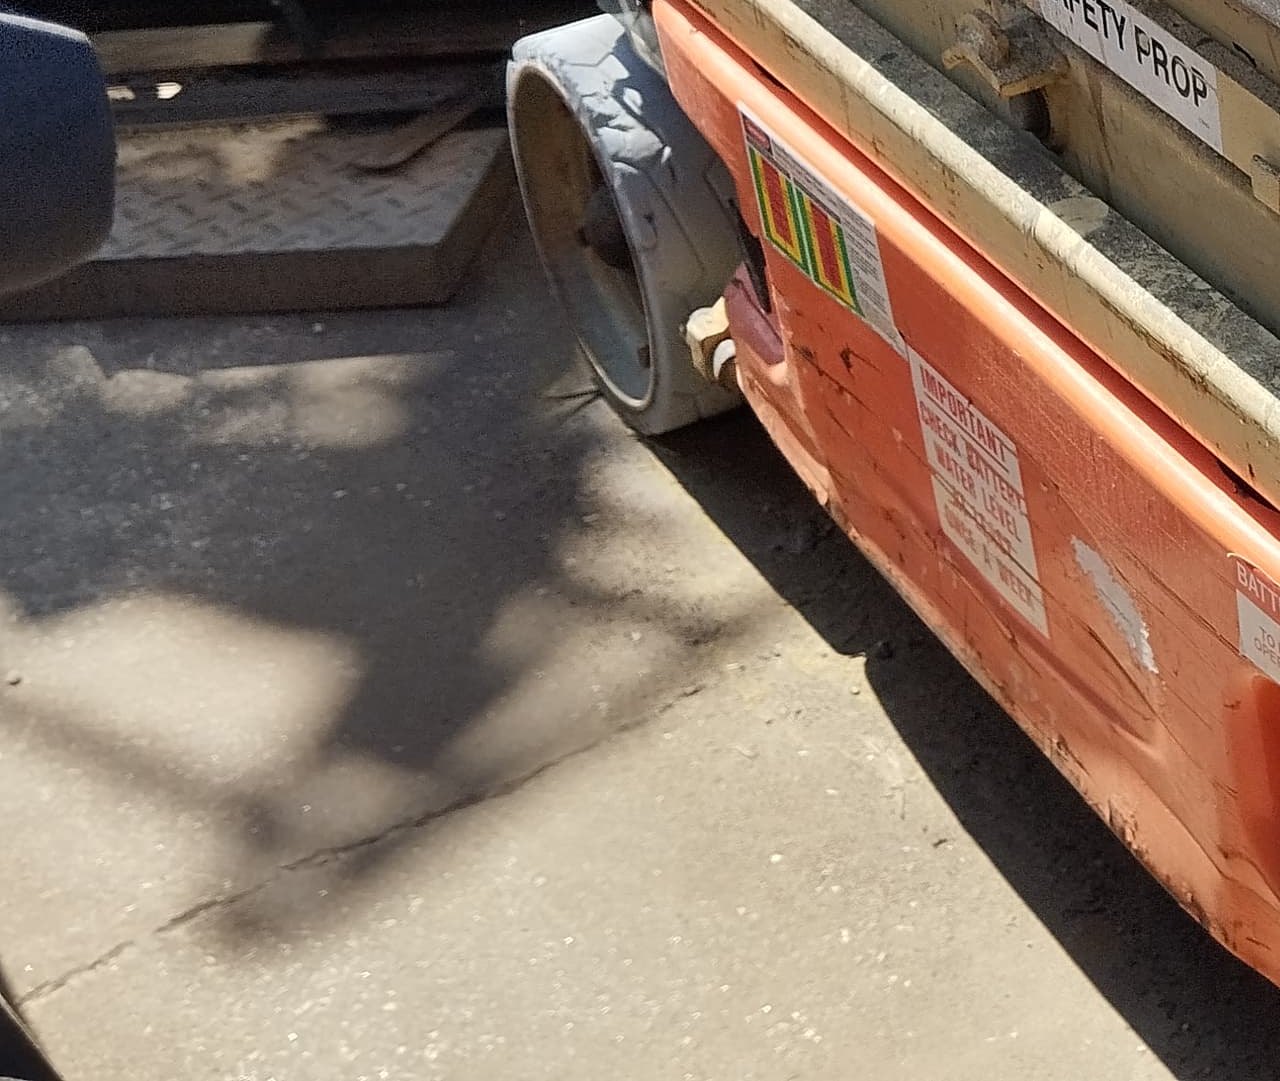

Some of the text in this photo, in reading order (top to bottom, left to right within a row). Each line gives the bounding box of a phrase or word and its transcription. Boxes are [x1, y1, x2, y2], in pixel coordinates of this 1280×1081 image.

[1134, 25, 1207, 108] PROP
[920, 365, 1007, 463] IMPORTANT
[980, 486, 1022, 544] LEVEL
[1259, 626, 1276, 649] TO
